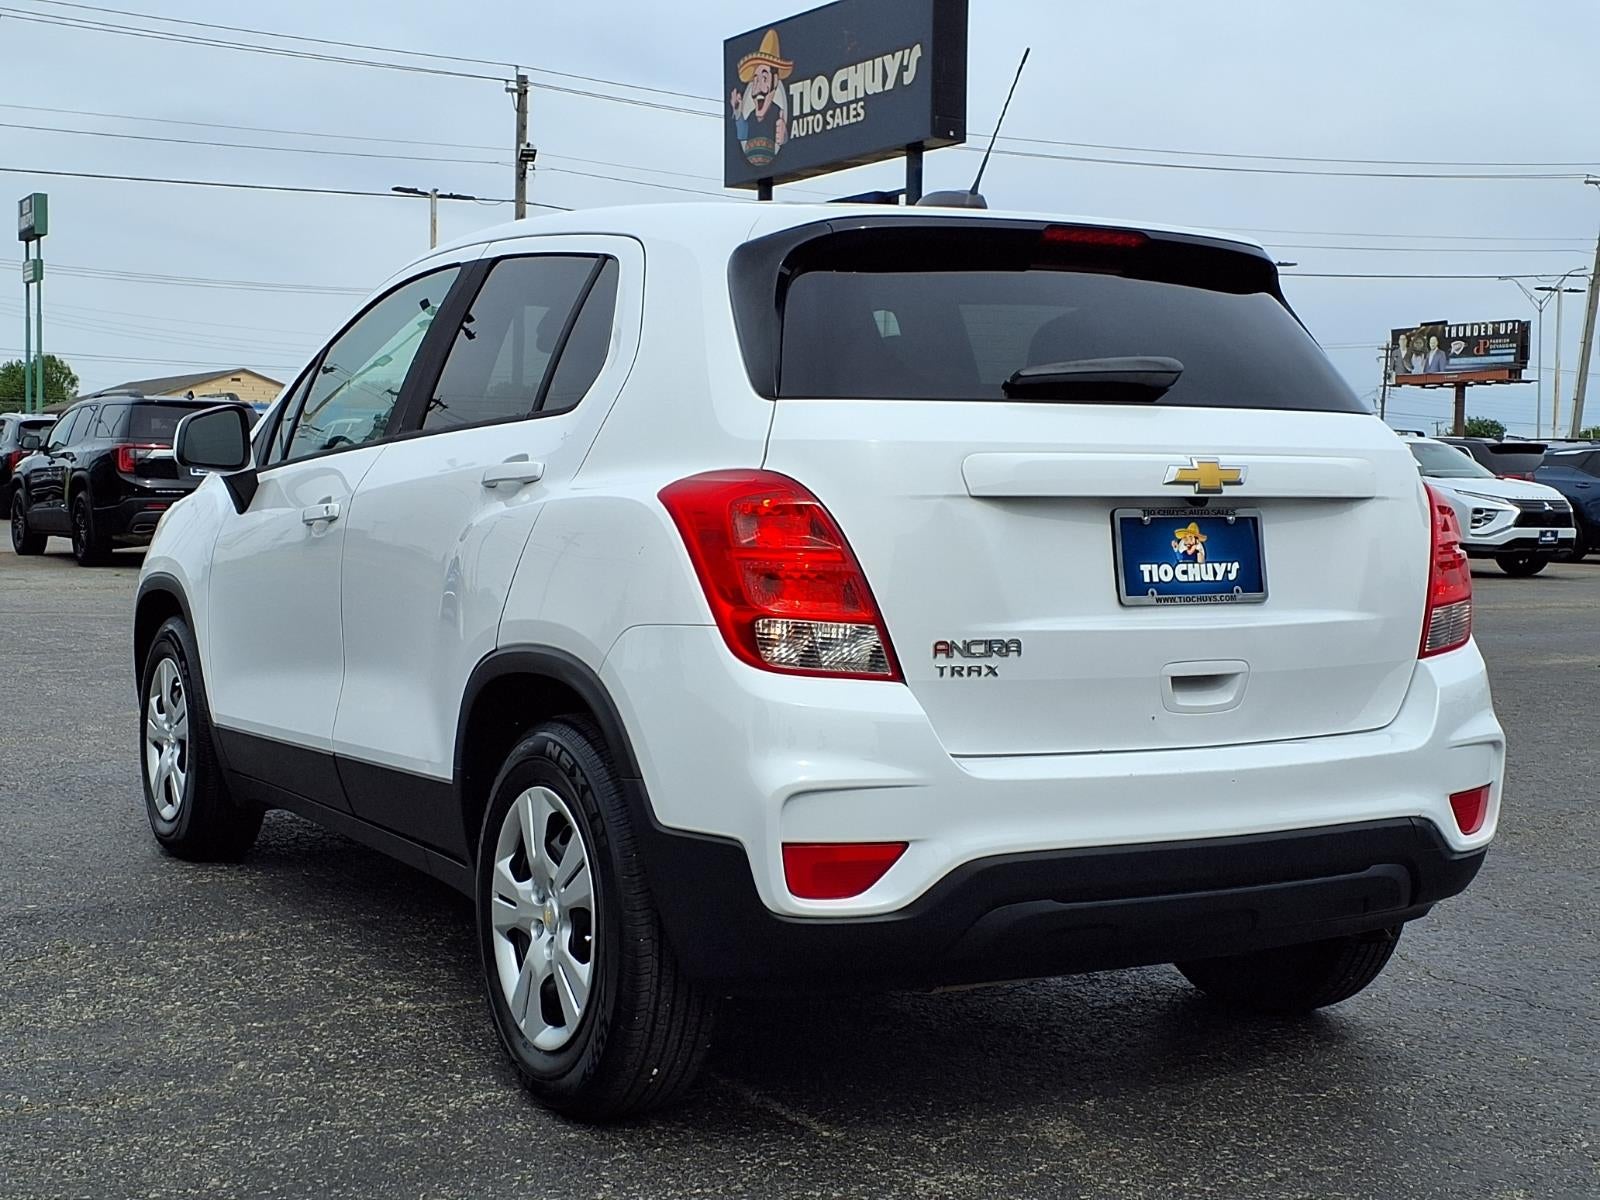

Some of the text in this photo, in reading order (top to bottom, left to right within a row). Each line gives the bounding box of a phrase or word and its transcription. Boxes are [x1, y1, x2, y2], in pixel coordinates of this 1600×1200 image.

[789, 44, 921, 116] TIO CHUY'S
[790, 101, 866, 139] AUTO SALES
[1445, 322, 1519, 338] THUNDER UP!
[1188, 508, 1210, 516] AUTO
[1211, 508, 1236, 516] SALES
[1140, 562, 1239, 582] TIO CHUY'S
[1156, 595, 1236, 603] WWW.TIOCHUYS.COM
[933, 638, 1022, 659] ANCIRA
[935, 664, 999, 678] TRAX
